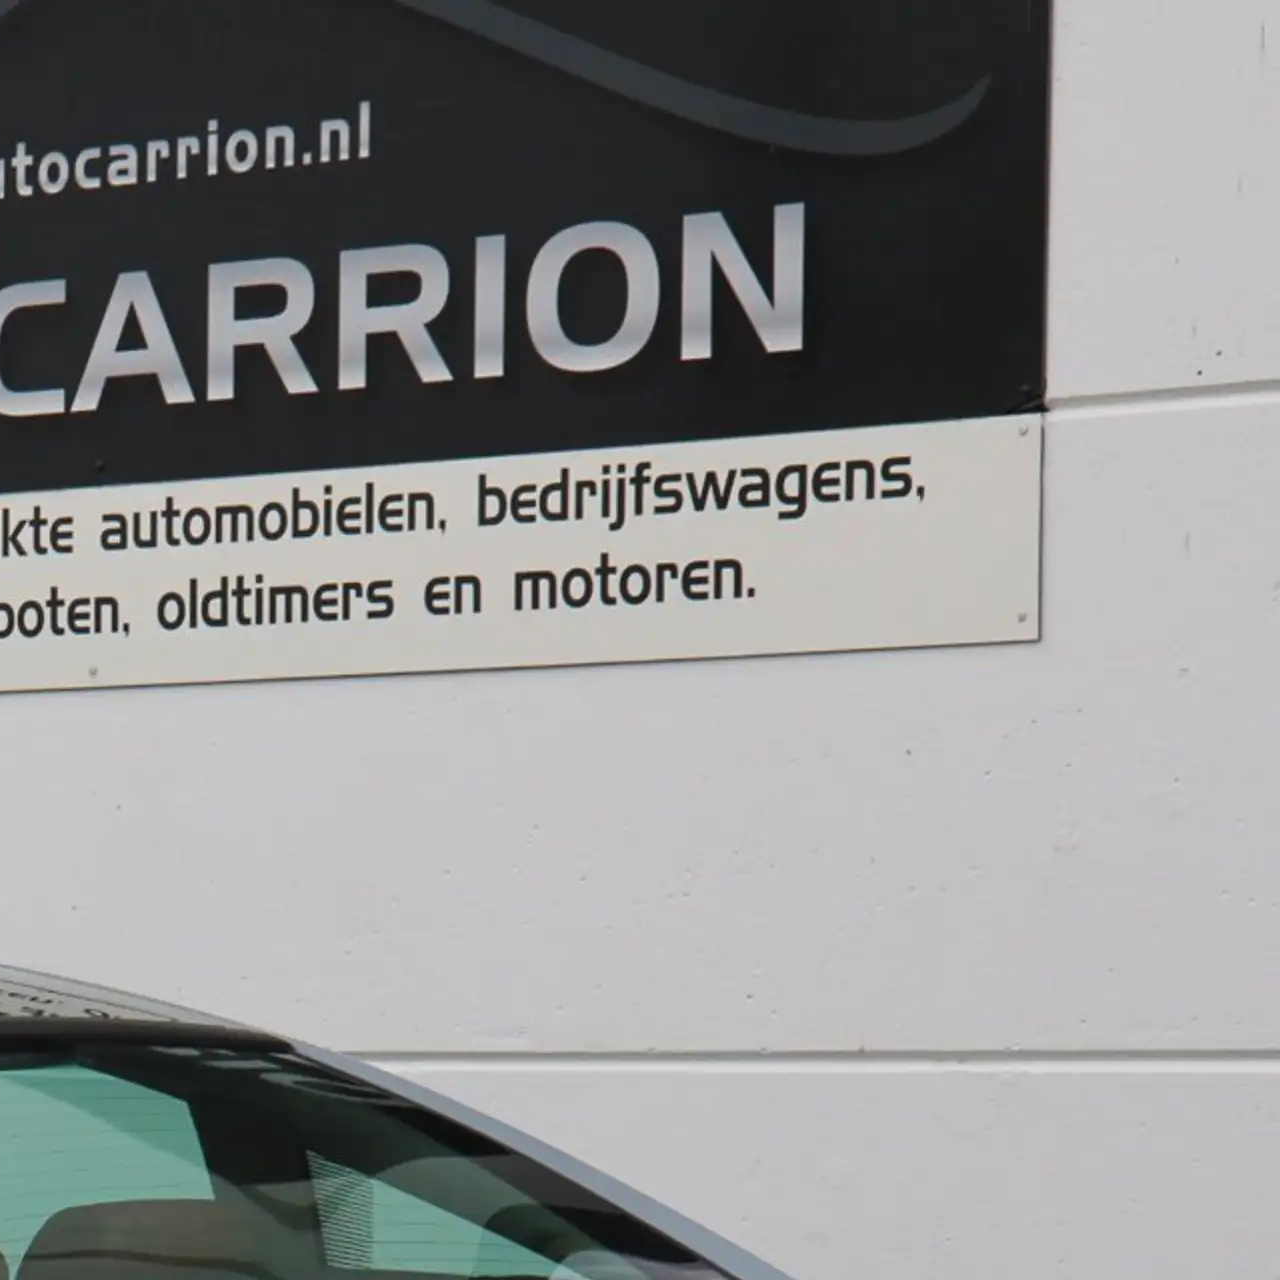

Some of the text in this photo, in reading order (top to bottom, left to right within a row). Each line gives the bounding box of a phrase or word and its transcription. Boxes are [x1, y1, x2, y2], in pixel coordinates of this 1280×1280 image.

[100, 482, 446, 551] automobielen,
[478, 456, 926, 532] bedrijfswagens,
[157, 574, 394, 631] oldtimers
[424, 575, 481, 616] en
[514, 552, 756, 611] motoren.
